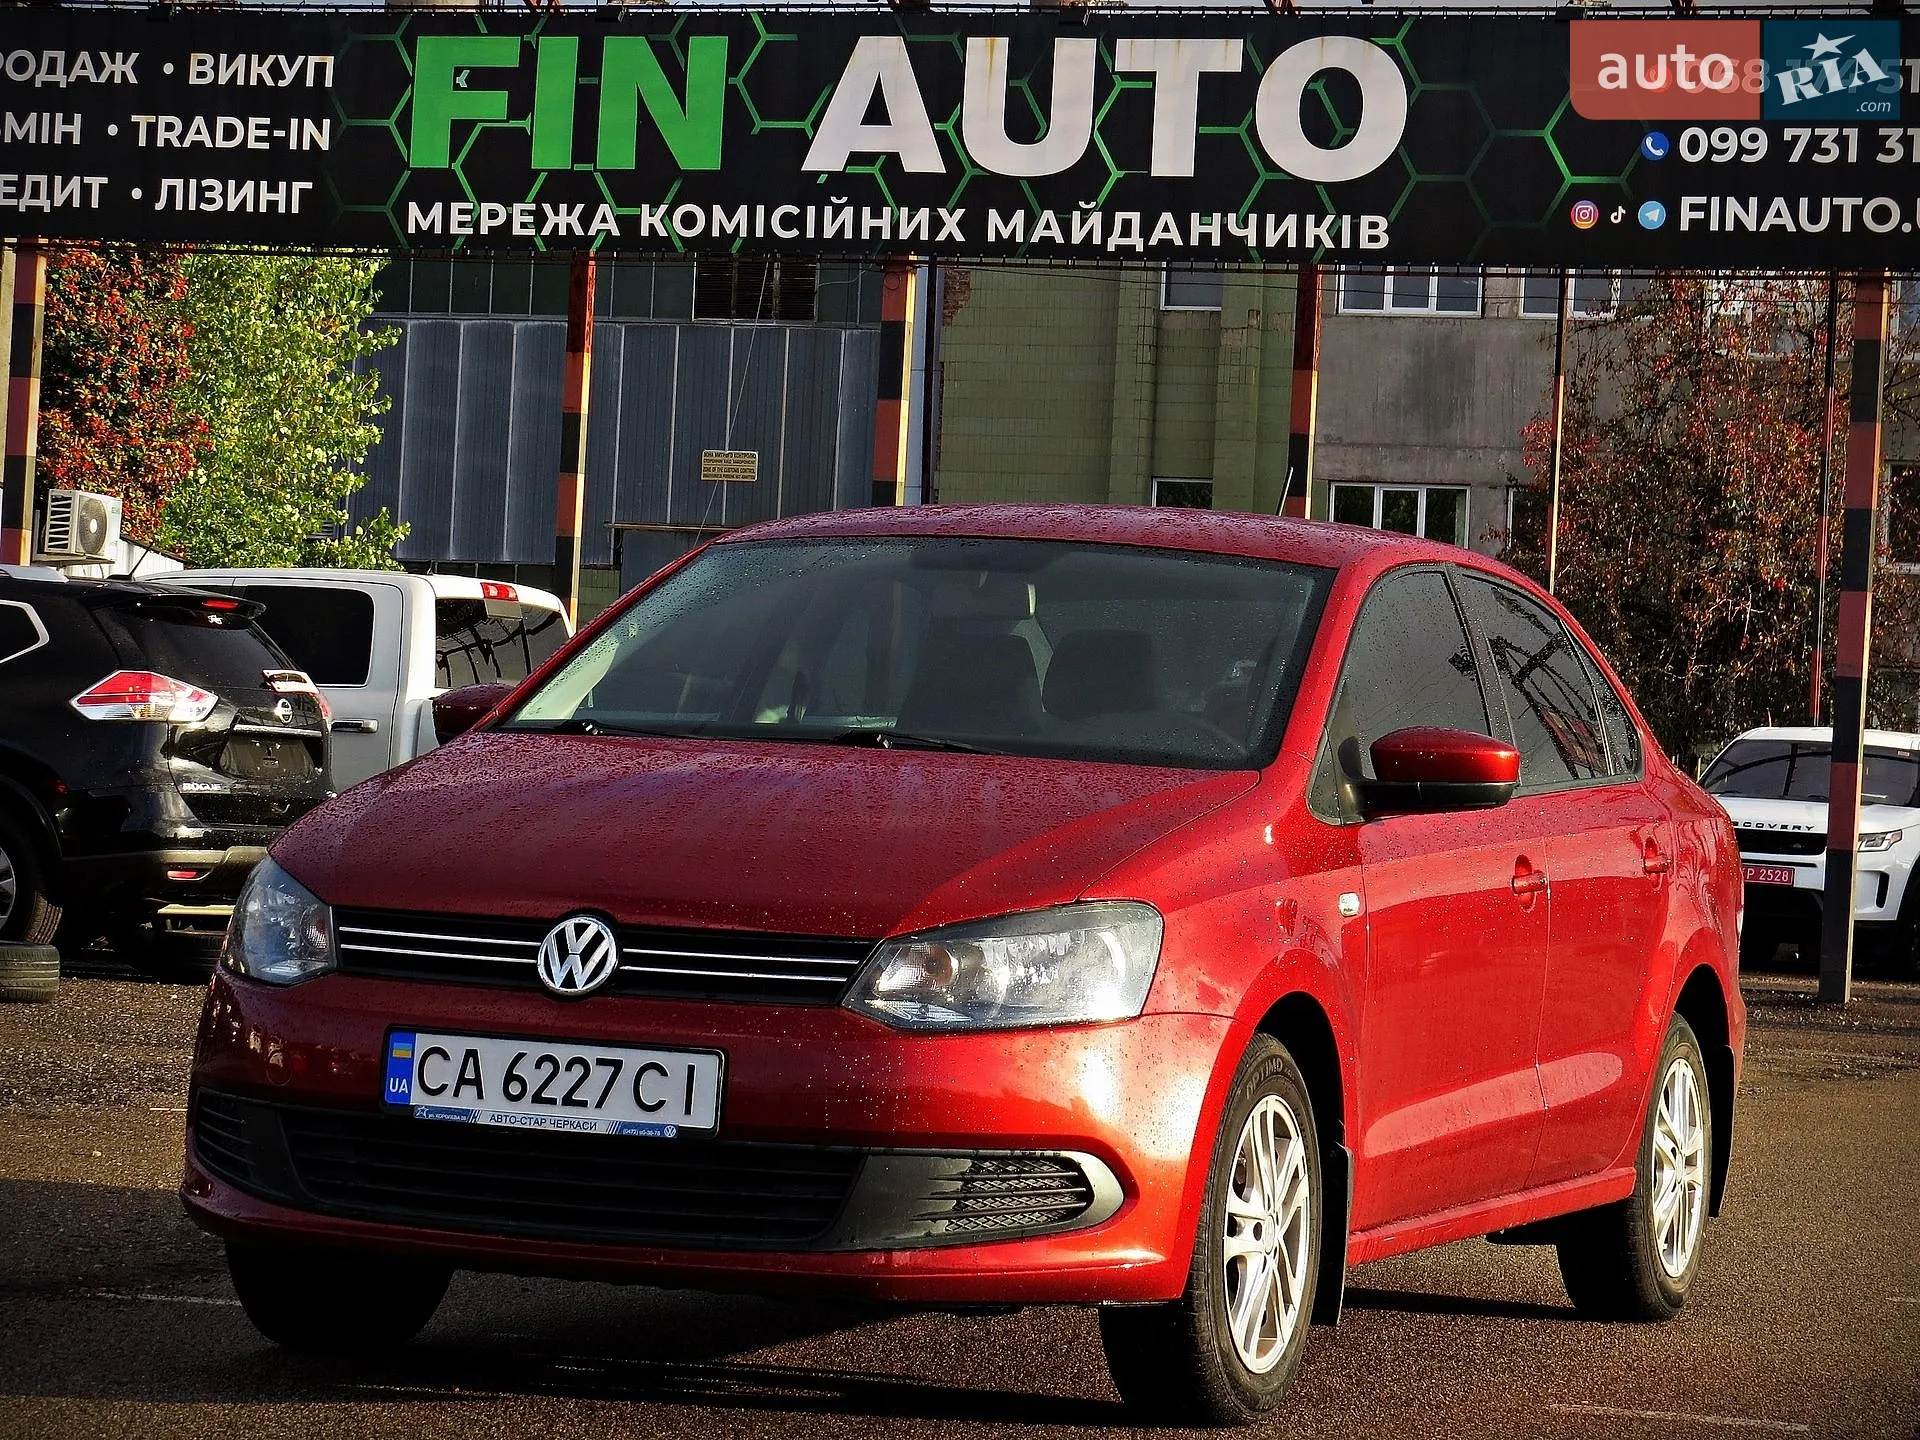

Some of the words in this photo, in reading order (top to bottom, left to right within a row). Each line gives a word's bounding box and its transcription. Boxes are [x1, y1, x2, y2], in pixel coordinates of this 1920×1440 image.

[0, 50, 140, 88] ОДАЖ
[188, 53, 335, 88] ВИКУП
[409, 35, 728, 170] FIN
[801, 35, 1408, 183] AUTO
[0, 112, 82, 145] МІН
[131, 115, 331, 151] TRADE-IN
[1679, 126, 1769, 163] 099
[1783, 127, 1859, 163] 731
[1876, 127, 1920, 163] 31
[155, 178, 313, 214] ЛІЗИНГ
[1680, 196, 1920, 233] FINAUTO.
[407, 201, 621, 238] МЕРЕЖА
[640, 196, 966, 242] КОМІСІЙНИХ
[987, 201, 1390, 252] МАЙДАНЧИКІВ
[1742, 867, 1755, 880] P
[1759, 869, 1789, 882] 2528
[389, 1077, 409, 1094] UA
[417, 1045, 485, 1100] CA
[502, 1052, 624, 1109] 6227
[633, 1061, 696, 1116] CI
[489, 1113, 547, 1126] АВТО-СТАР
[549, 1119, 597, 1131] ЧЕРКАСИ
